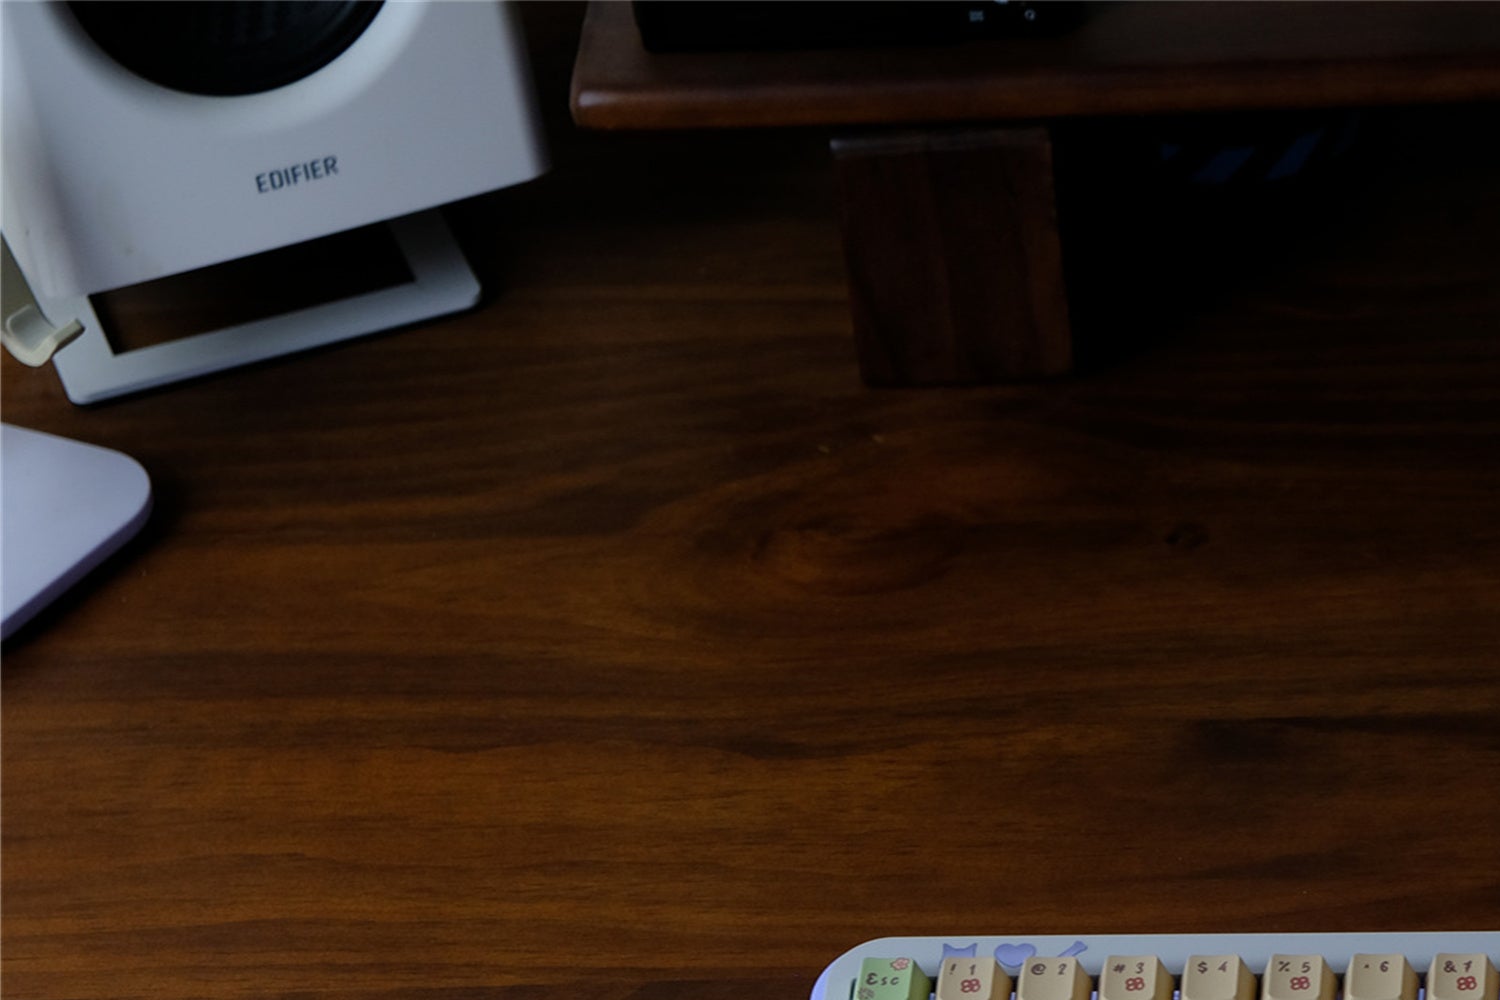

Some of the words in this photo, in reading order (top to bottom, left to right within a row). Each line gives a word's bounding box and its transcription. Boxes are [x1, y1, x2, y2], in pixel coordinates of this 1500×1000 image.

[255, 155, 338, 194] EDIFIER
[969, 964, 977, 976] 1
[1057, 962, 1068, 976] 2
[1135, 961, 1145, 975] 3
[1217, 960, 1228, 973] 4
[1301, 961, 1311, 974] 5
[1379, 960, 1390, 973] 6
[1463, 960, 1473, 973] 7
[865, 972, 899, 986] Esc
